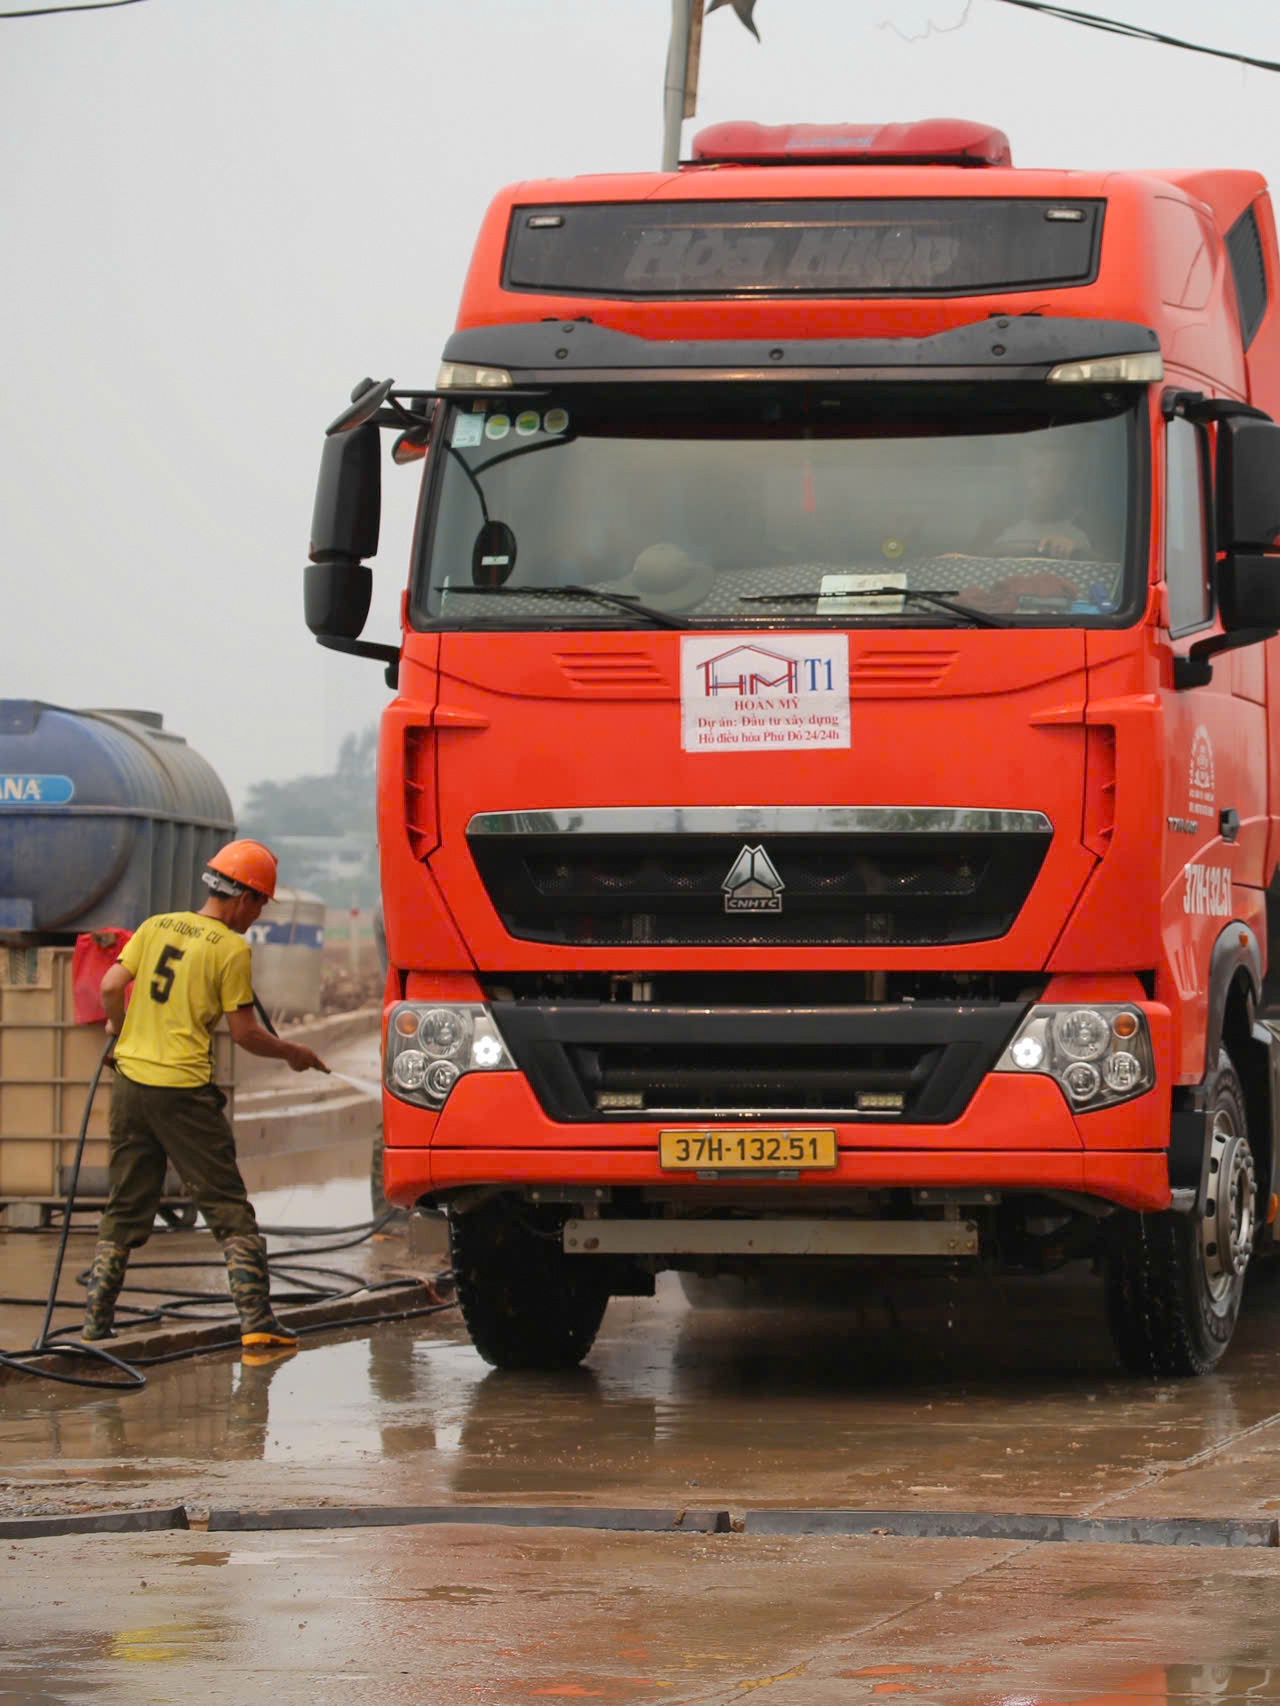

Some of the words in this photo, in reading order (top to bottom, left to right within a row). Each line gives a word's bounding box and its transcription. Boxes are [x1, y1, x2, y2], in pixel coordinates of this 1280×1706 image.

[804, 658, 835, 692] T1
[808, 713, 840, 727] dựng
[805, 729, 840, 741] 24/24h
[0, 777, 41, 800] NA
[728, 899, 778, 909] CNHTC
[149, 943, 187, 1005] 5
[675, 1137, 818, 1161] 37H-132.51
